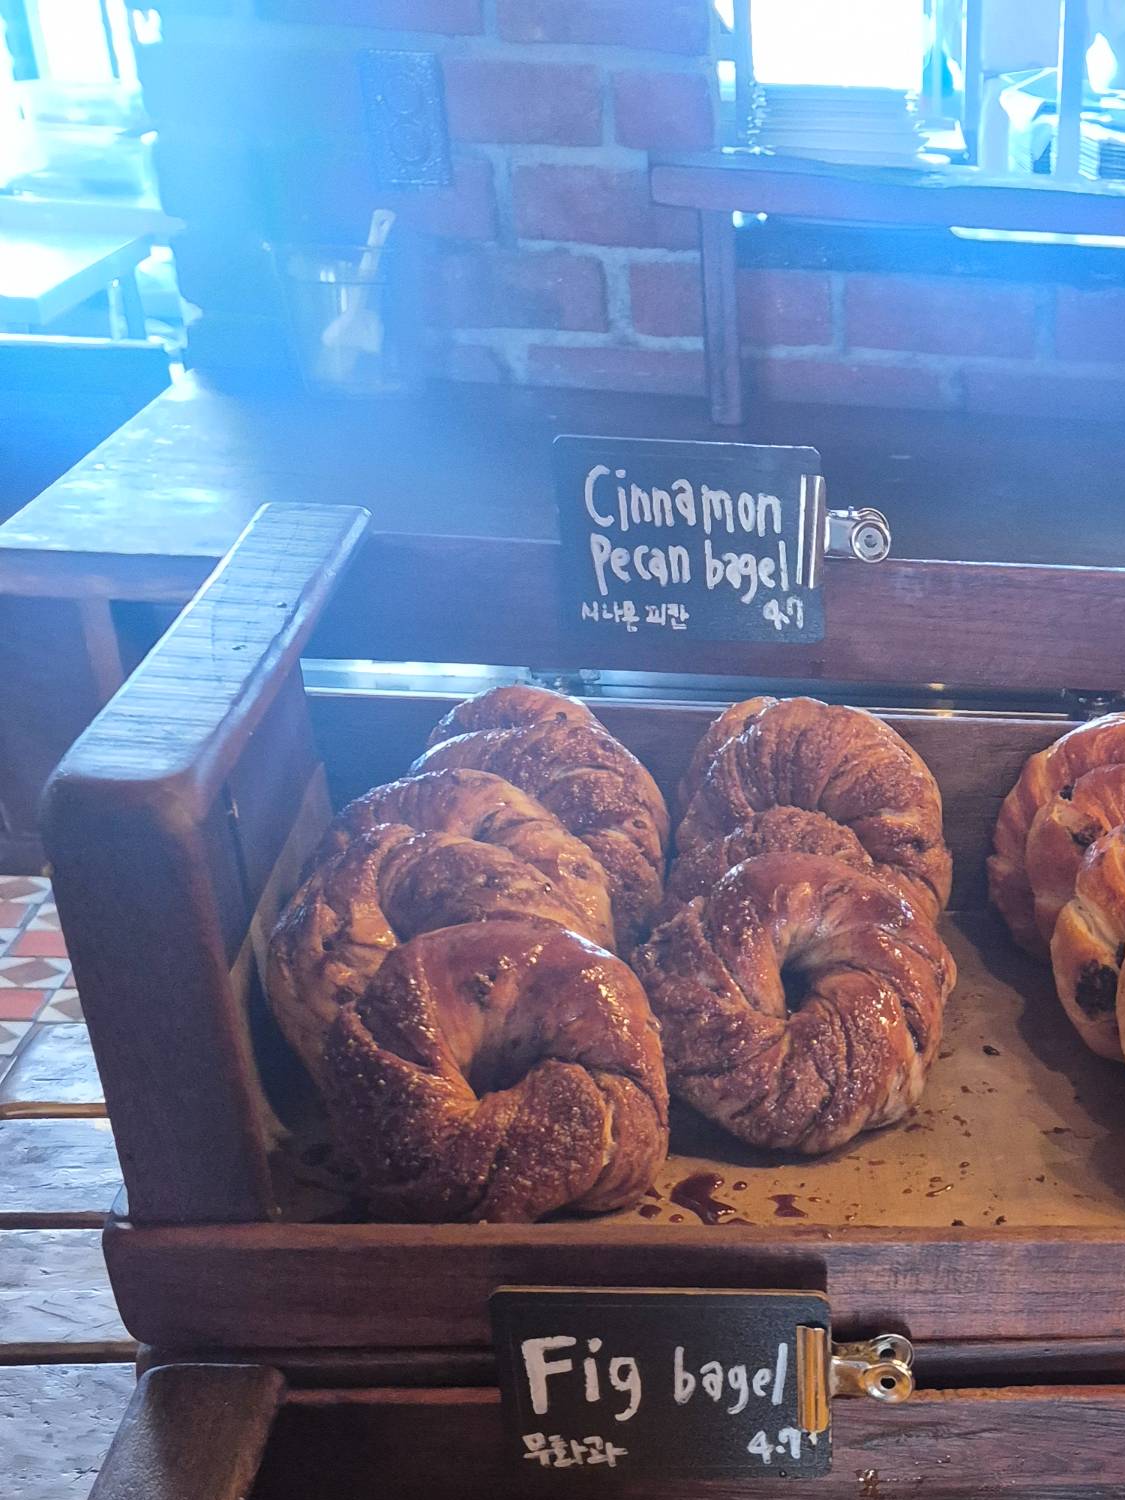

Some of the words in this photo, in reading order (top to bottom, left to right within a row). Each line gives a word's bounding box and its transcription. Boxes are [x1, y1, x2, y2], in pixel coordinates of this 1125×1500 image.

[584, 464, 782, 537] Cinnamon
[590, 532, 692, 596] Pecan
[704, 539, 789, 604] bagel
[581, 600, 641, 633] 시나몬
[644, 603, 690, 630] 피칸
[521, 1335, 642, 1421] Fig
[673, 1342, 789, 1416] bagel
[522, 1431, 629, 1468] 무화과
[746, 1426, 802, 1465] 4.7
